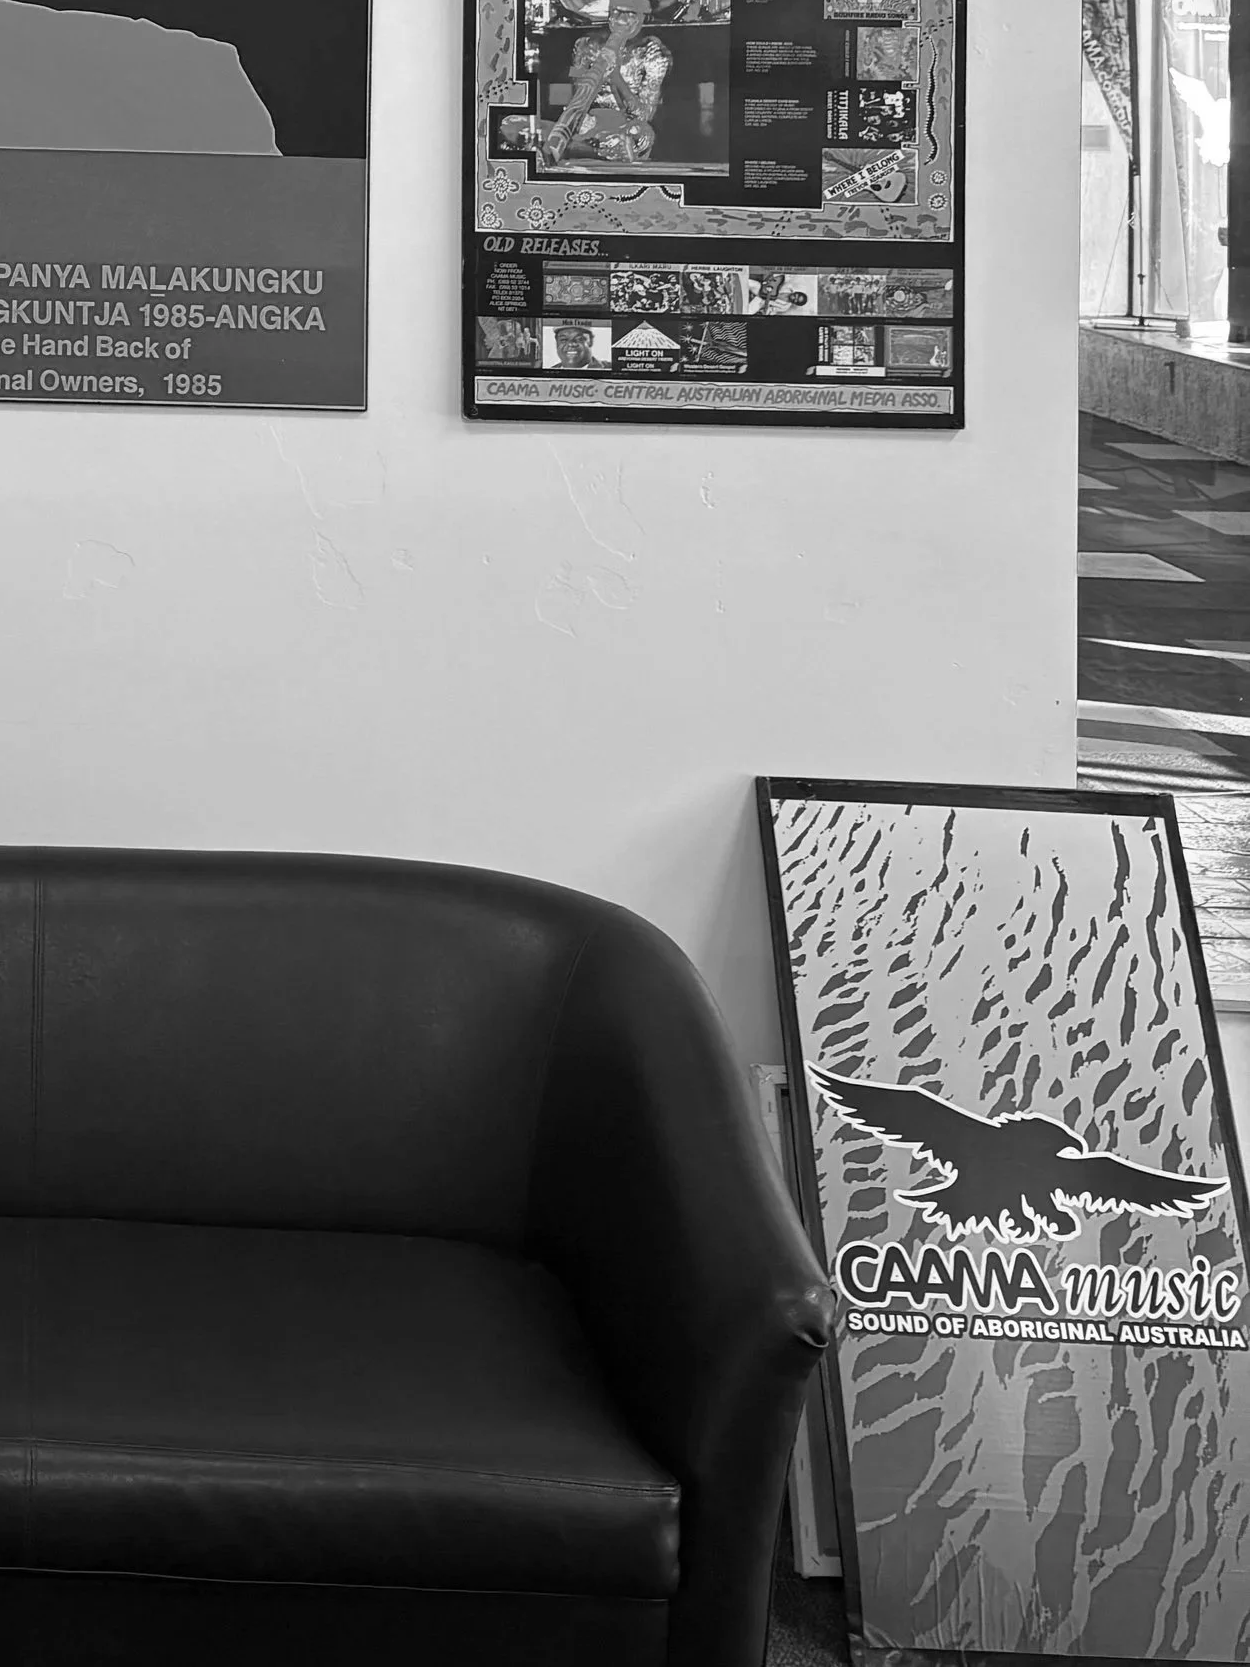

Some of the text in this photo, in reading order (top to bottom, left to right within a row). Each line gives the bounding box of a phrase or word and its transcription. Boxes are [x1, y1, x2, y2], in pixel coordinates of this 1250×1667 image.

[827, 175, 857, 196] WHERE
[866, 153, 900, 175] BELONG
[483, 236, 515, 253] OLD
[139, 304, 326, 332] 1985-ANGKA
[22, 334, 89, 358] Hand
[96, 335, 159, 359] Back
[165, 337, 192, 360] of
[625, 349, 664, 357] LIGHT ON
[39, 369, 145, 397] Owners,
[163, 373, 222, 396] 1985
[487, 382, 540, 398] CAAMA
[604, 385, 673, 400] CENTRAL
[677, 386, 761, 402] AUSTRALIAN
[764, 389, 847, 406] ABORIGINAL
[850, 391, 895, 406] MEDIA
[837, 1241, 1242, 1322] CAAMA music
[848, 1313, 1247, 1348] SOUND OF ABORIGINAL AUSTRALIA
